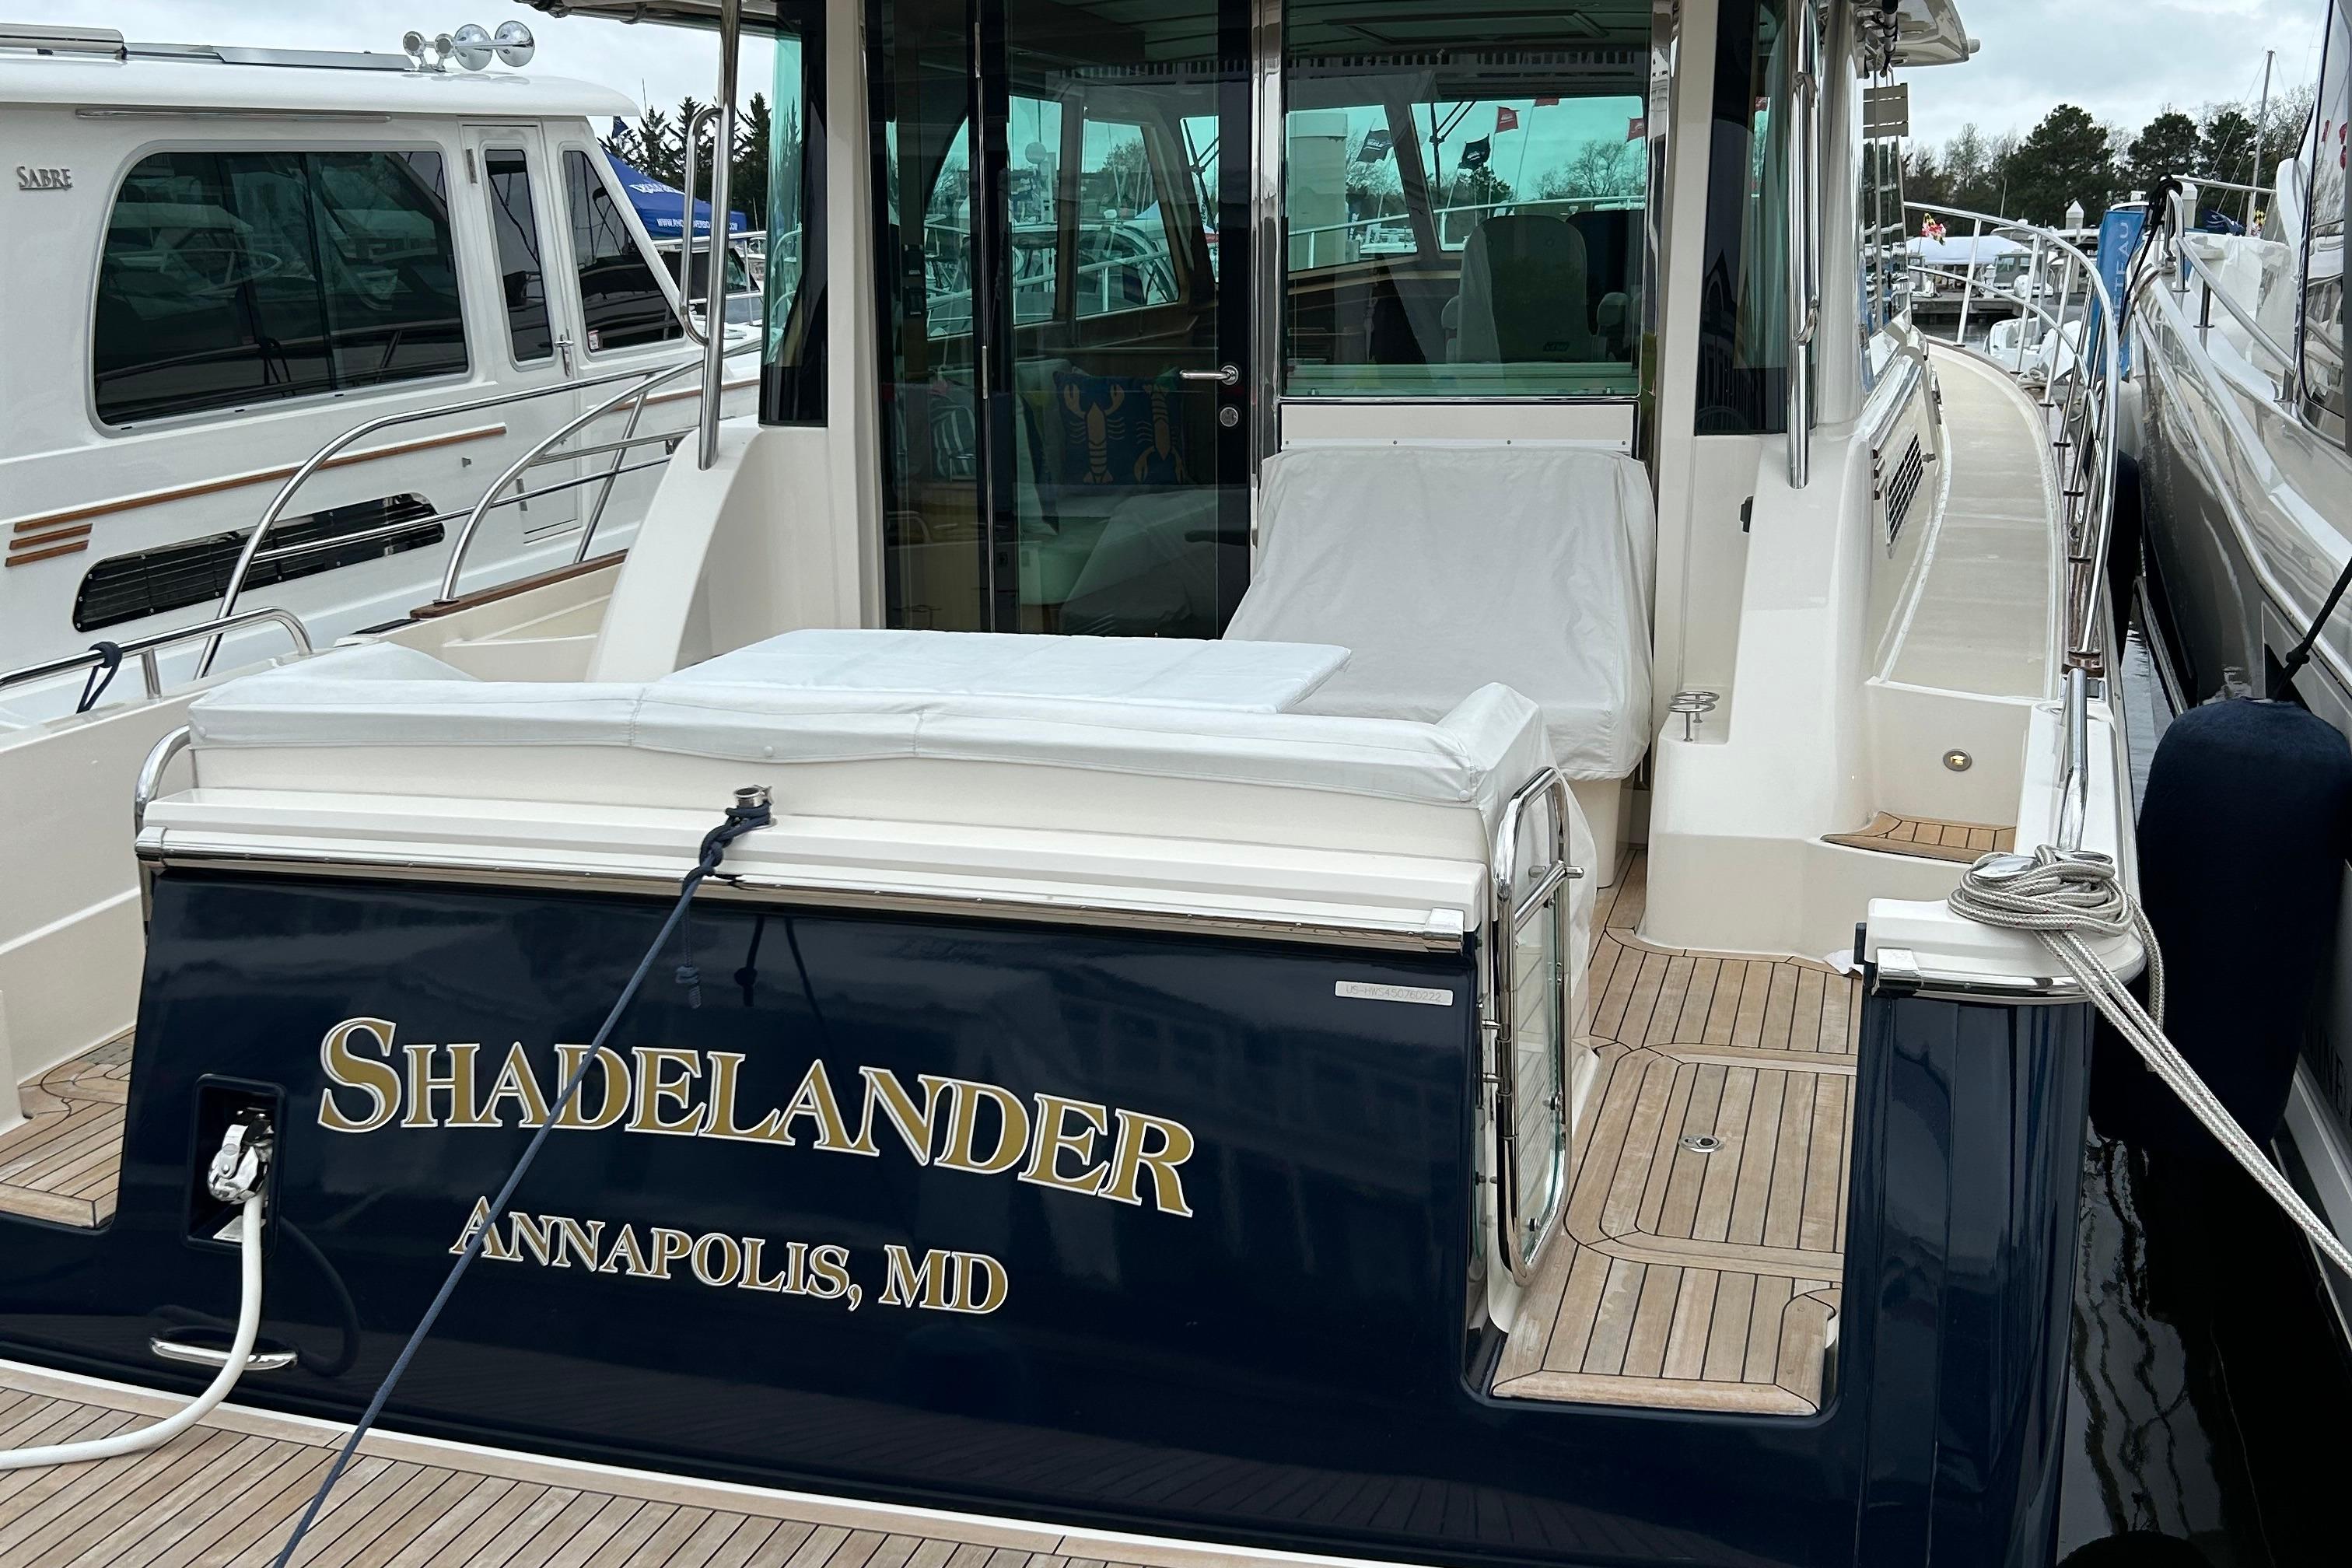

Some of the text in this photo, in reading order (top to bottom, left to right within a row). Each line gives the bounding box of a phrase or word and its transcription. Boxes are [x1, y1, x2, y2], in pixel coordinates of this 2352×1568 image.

[16, 166, 73, 188] SABRE
[317, 1016, 1195, 1217] SHADELANDER
[449, 1196, 1010, 1314] ANNAPOLIS, MD
